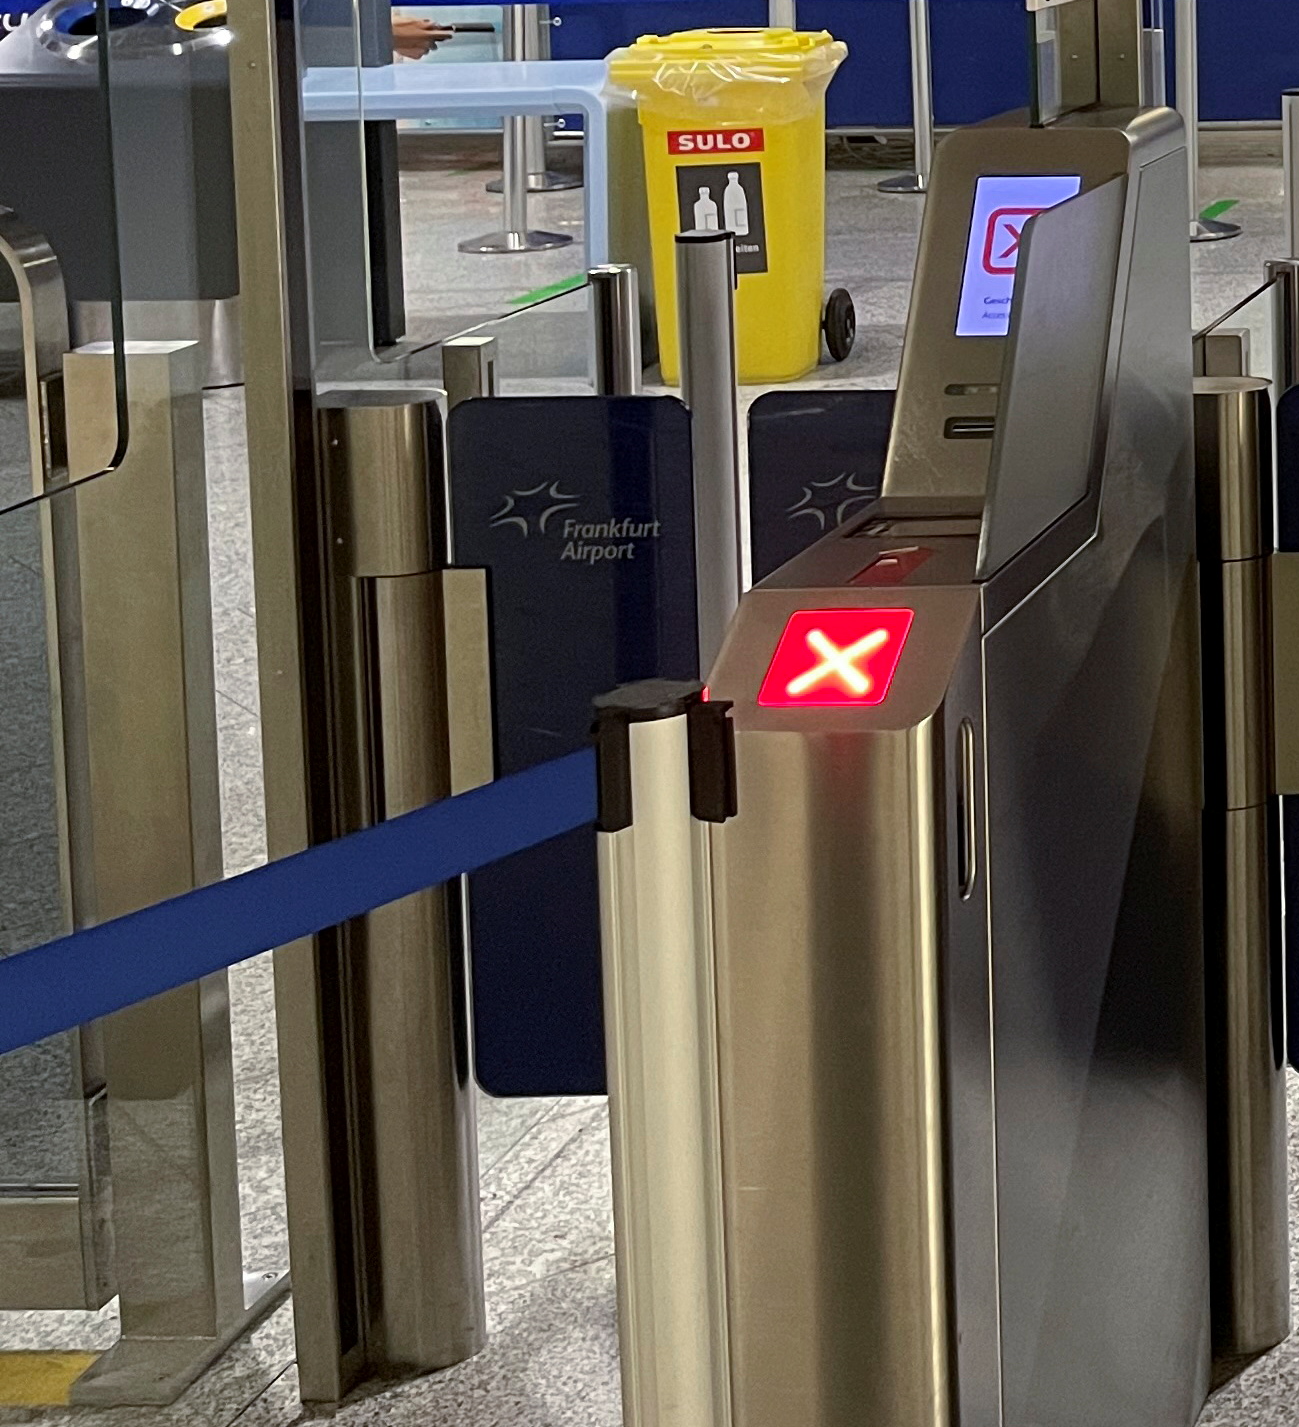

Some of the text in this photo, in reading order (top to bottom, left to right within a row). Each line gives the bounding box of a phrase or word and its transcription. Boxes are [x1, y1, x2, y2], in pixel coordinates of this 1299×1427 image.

[678, 132, 751, 151] SULO
[562, 517, 661, 539] Frankfurt
[560, 540, 635, 565] Airport
